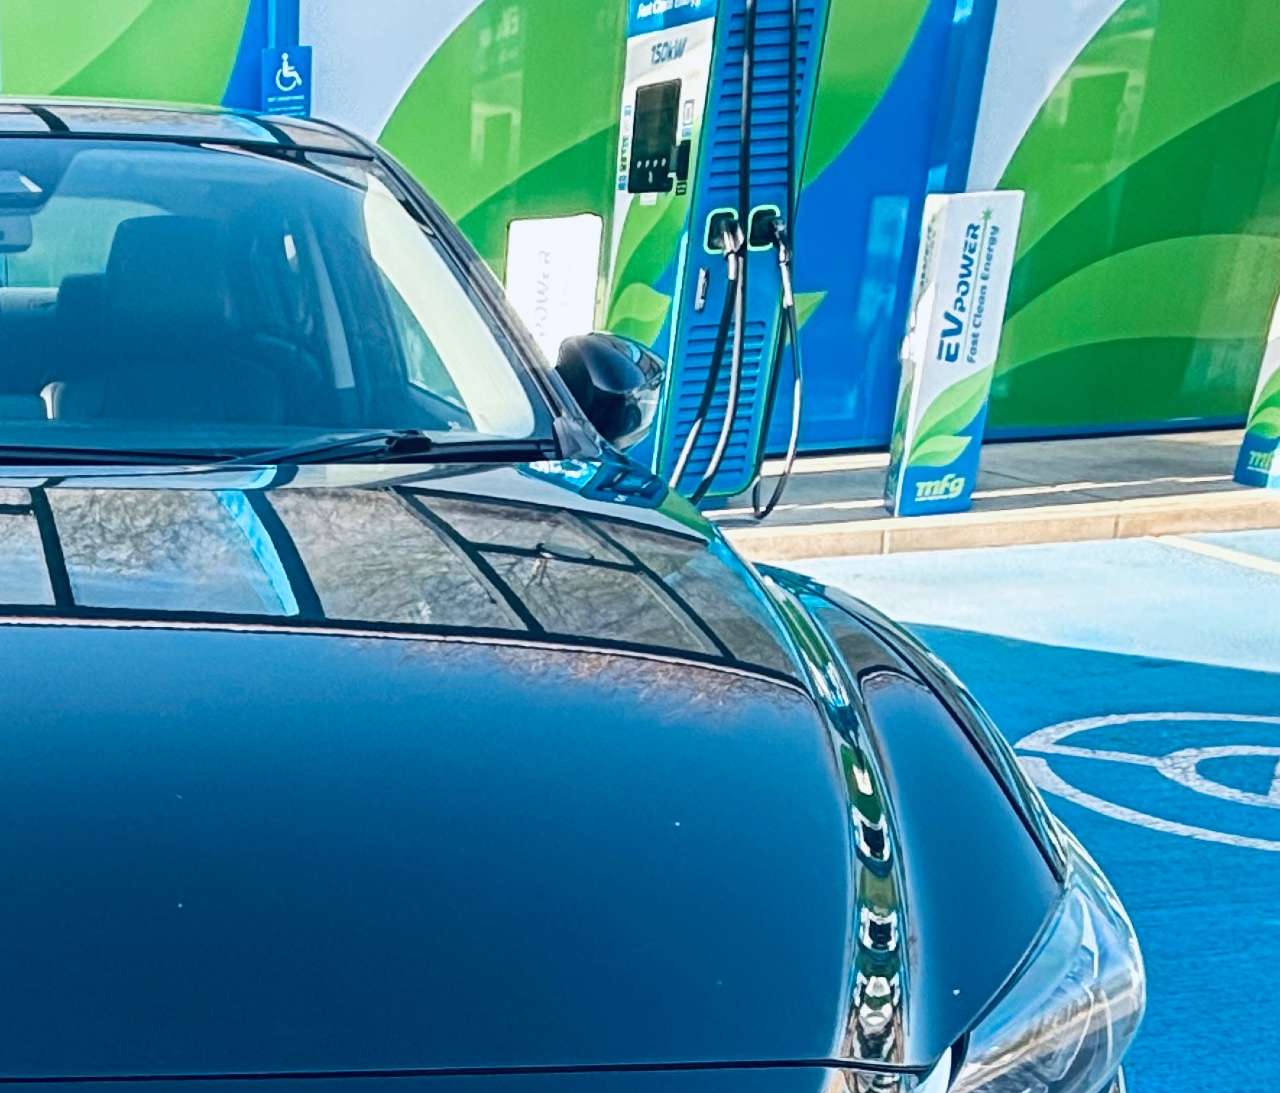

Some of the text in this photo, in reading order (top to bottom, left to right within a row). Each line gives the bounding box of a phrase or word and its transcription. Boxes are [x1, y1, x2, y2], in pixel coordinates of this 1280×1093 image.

[936, 222, 981, 364] EV POWER
[966, 225, 1001, 364] Fast Clean Energy
[915, 473, 966, 501] mfg
